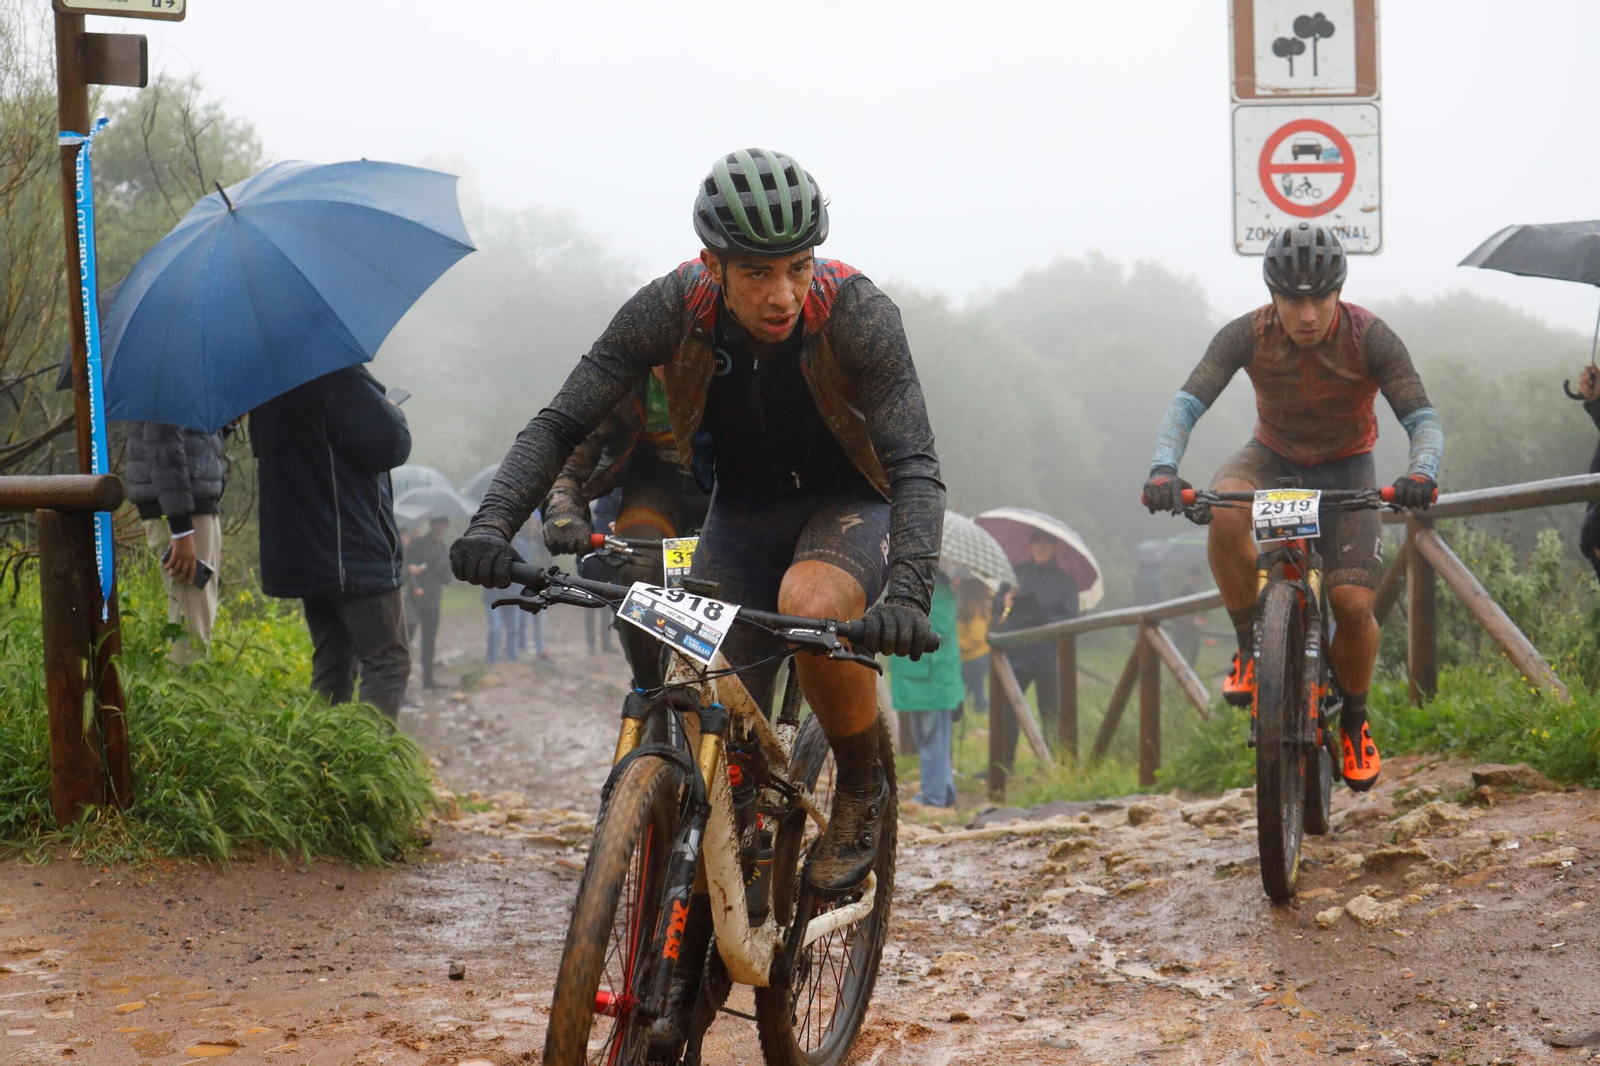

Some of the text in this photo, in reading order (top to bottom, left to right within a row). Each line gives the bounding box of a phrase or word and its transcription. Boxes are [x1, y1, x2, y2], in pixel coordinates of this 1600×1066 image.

[77, 210, 88, 280] CABELLO
[1246, 225, 1370, 240] ZON ONAL
[82, 287, 92, 357] CABELLO
[1259, 500, 1311, 516] 2919
[645, 587, 725, 622] 2918
[662, 900, 690, 961] FOX
